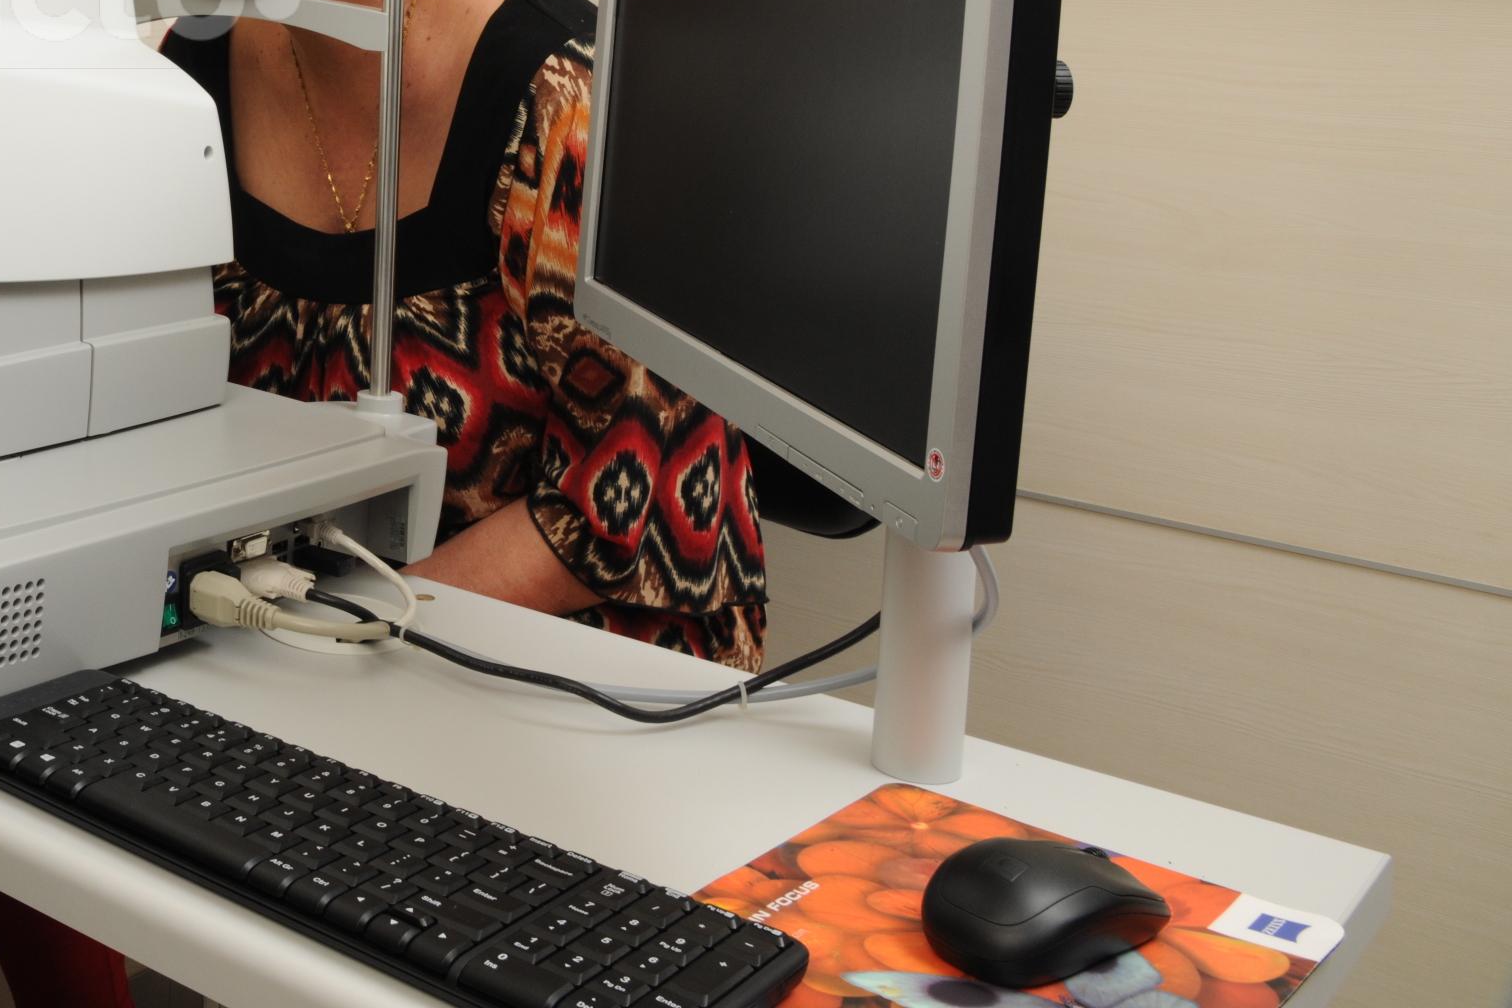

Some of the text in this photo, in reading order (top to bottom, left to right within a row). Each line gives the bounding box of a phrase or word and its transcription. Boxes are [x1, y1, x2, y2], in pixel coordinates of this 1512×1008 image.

[312, 876, 330, 887] Ctrl
[748, 880, 821, 923] IN FOCUS
